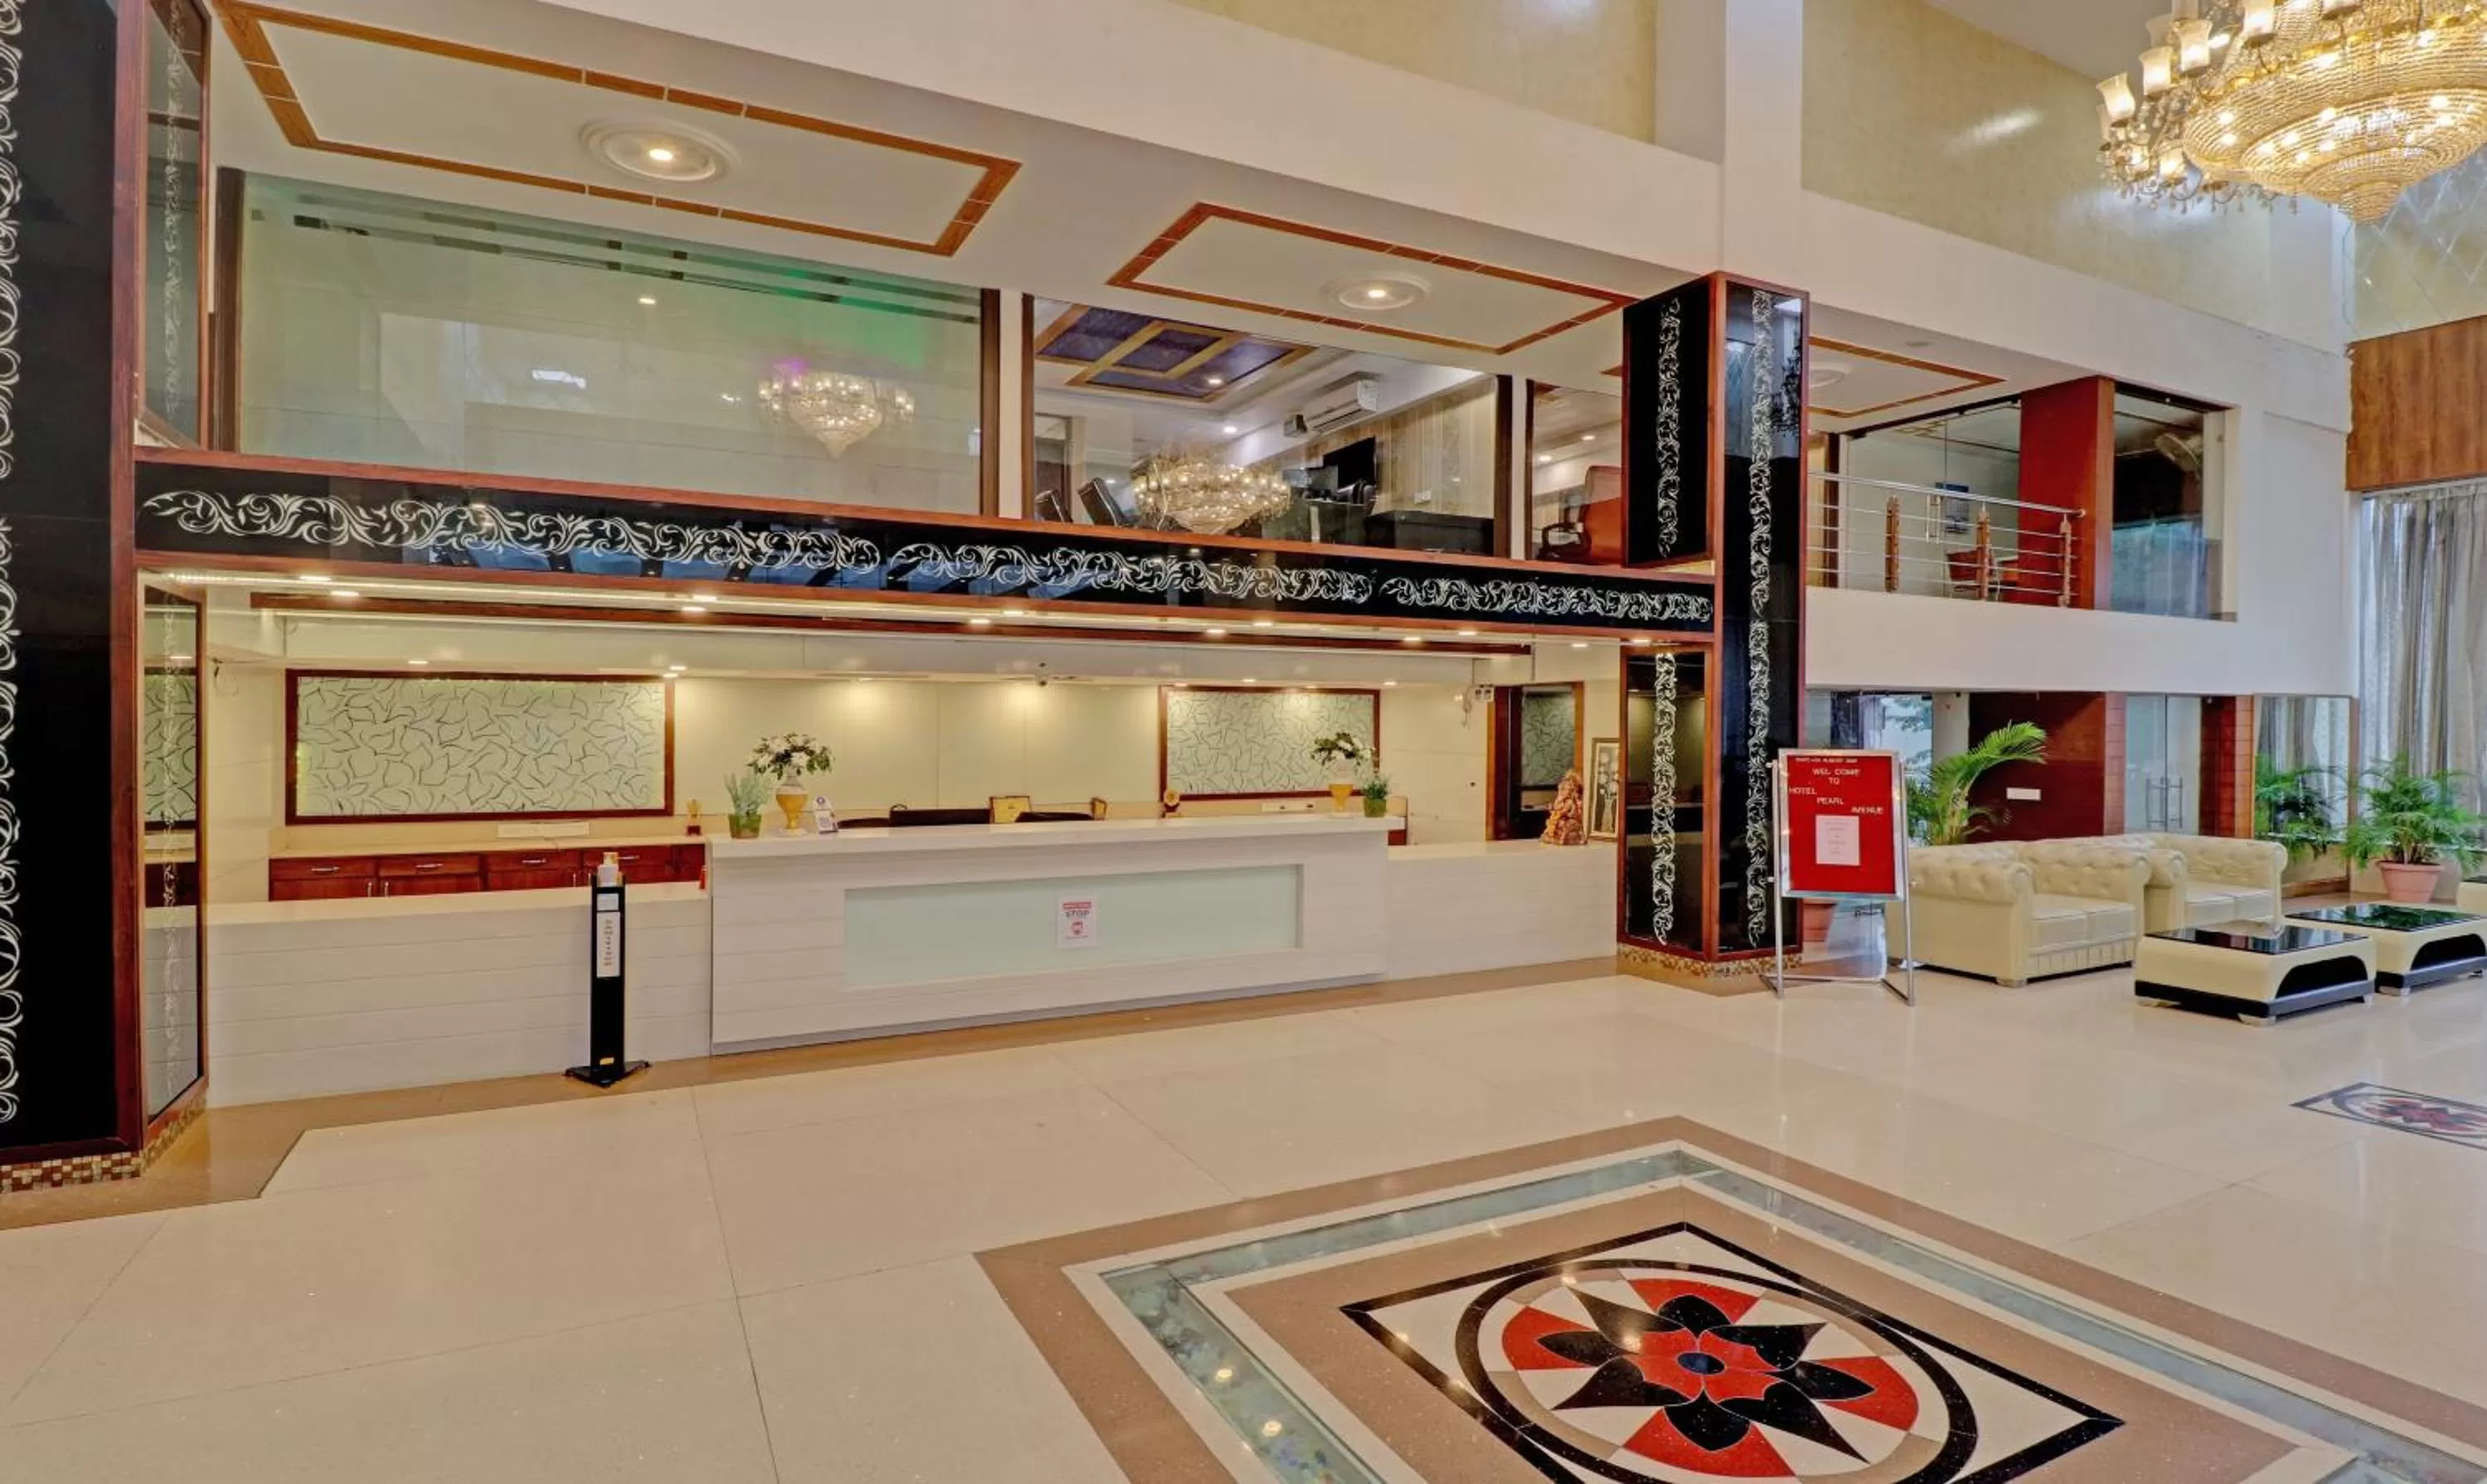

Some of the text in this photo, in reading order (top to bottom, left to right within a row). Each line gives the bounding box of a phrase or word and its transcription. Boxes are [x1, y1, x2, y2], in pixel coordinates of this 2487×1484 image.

[1835, 769, 1860, 777] COME
[1828, 777, 1840, 785] TO
[1788, 787, 1817, 795] HOTEL
[1816, 797, 1844, 805] PEARL
[1851, 806, 1883, 814] AVENUE
